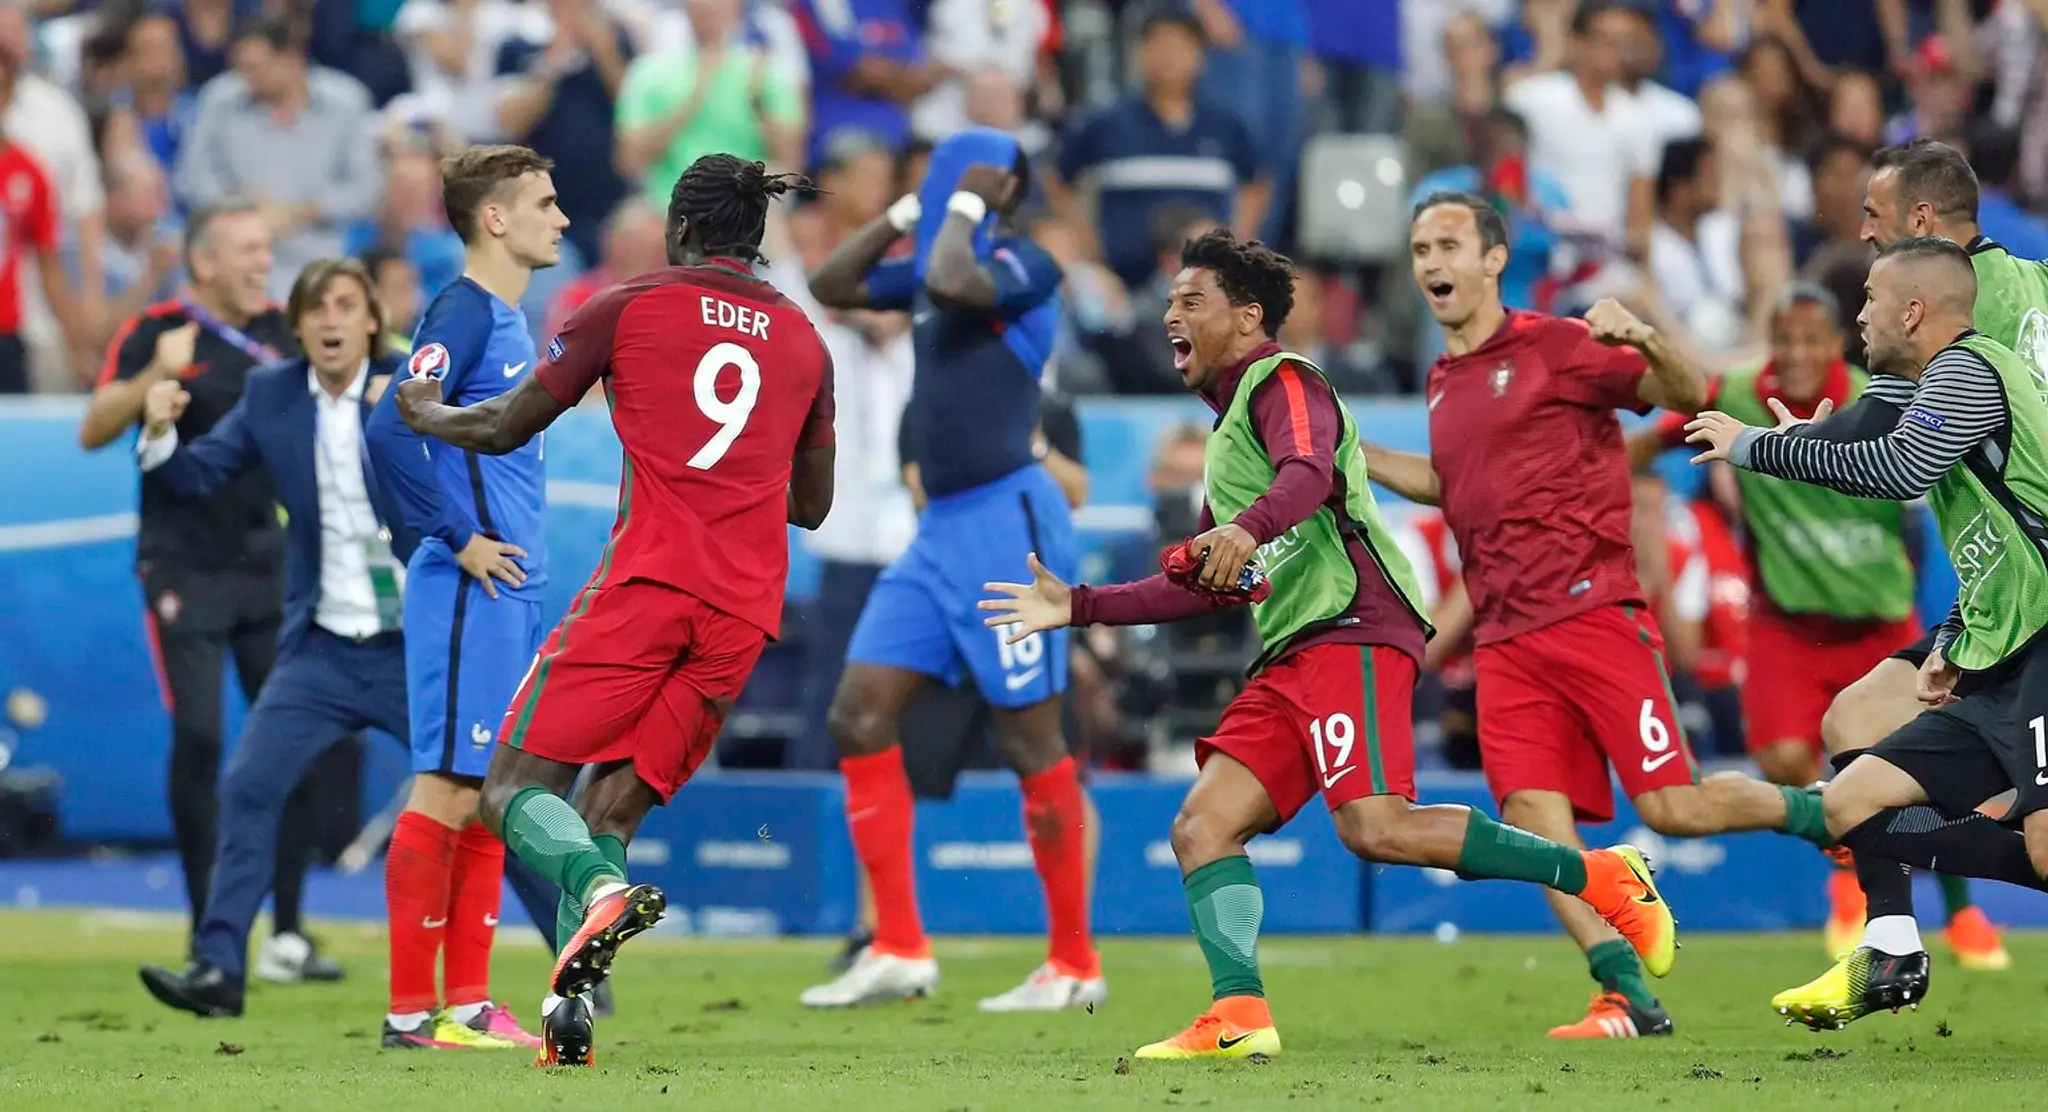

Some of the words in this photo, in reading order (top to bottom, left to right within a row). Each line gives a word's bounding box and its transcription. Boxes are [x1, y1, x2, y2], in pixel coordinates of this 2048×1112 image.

[701, 295, 770, 341] EDER
[686, 342, 762, 471] 9
[1957, 517, 2010, 592] ESPEC
[1309, 712, 1355, 774] 19
[1639, 698, 1670, 752] 6
